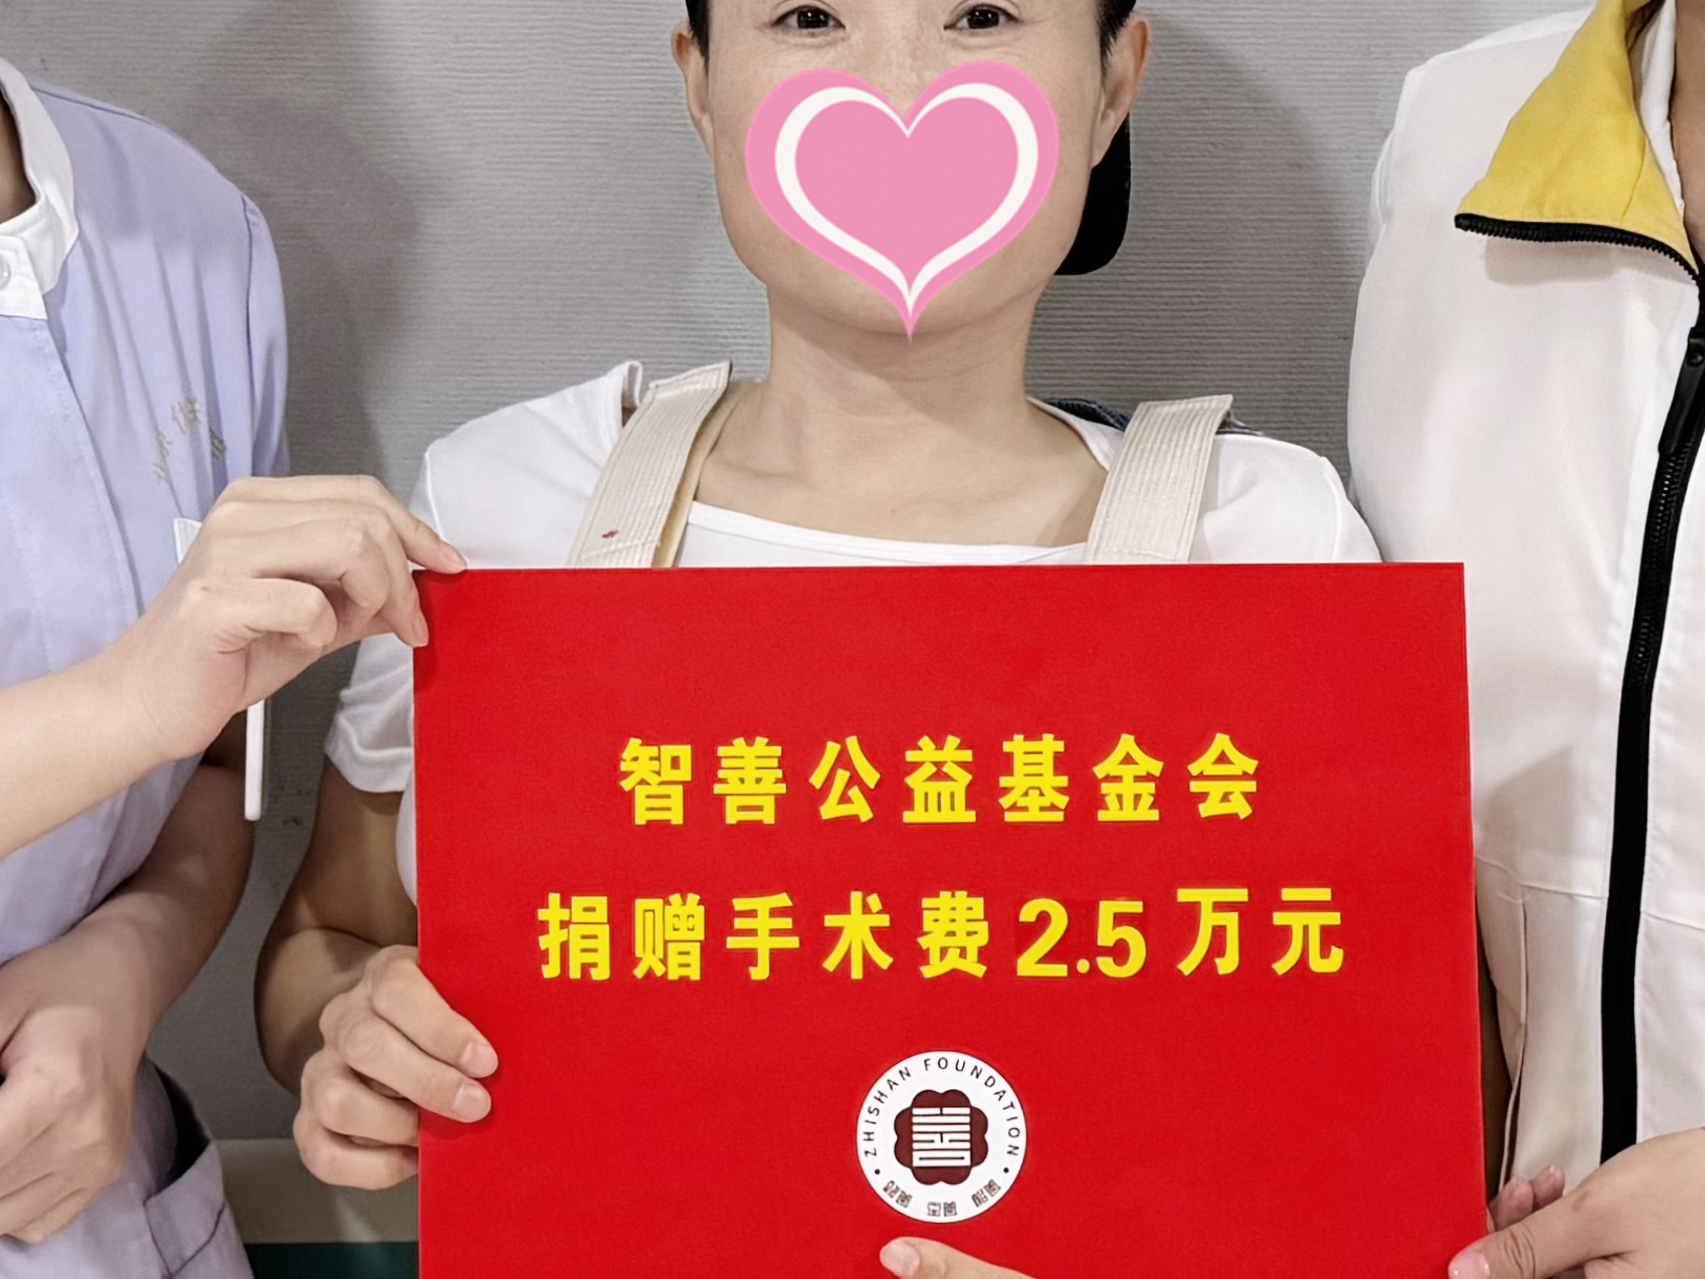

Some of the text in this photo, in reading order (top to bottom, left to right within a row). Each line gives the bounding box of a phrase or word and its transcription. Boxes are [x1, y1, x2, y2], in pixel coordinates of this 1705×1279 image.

[618, 732, 1258, 825] 智善公益基金会
[536, 886, 1344, 981] 捐赠手术费2.5万元
[863, 1066, 912, 1157] ZHISHAN
[924, 1057, 1020, 1156] FOUNDATION
